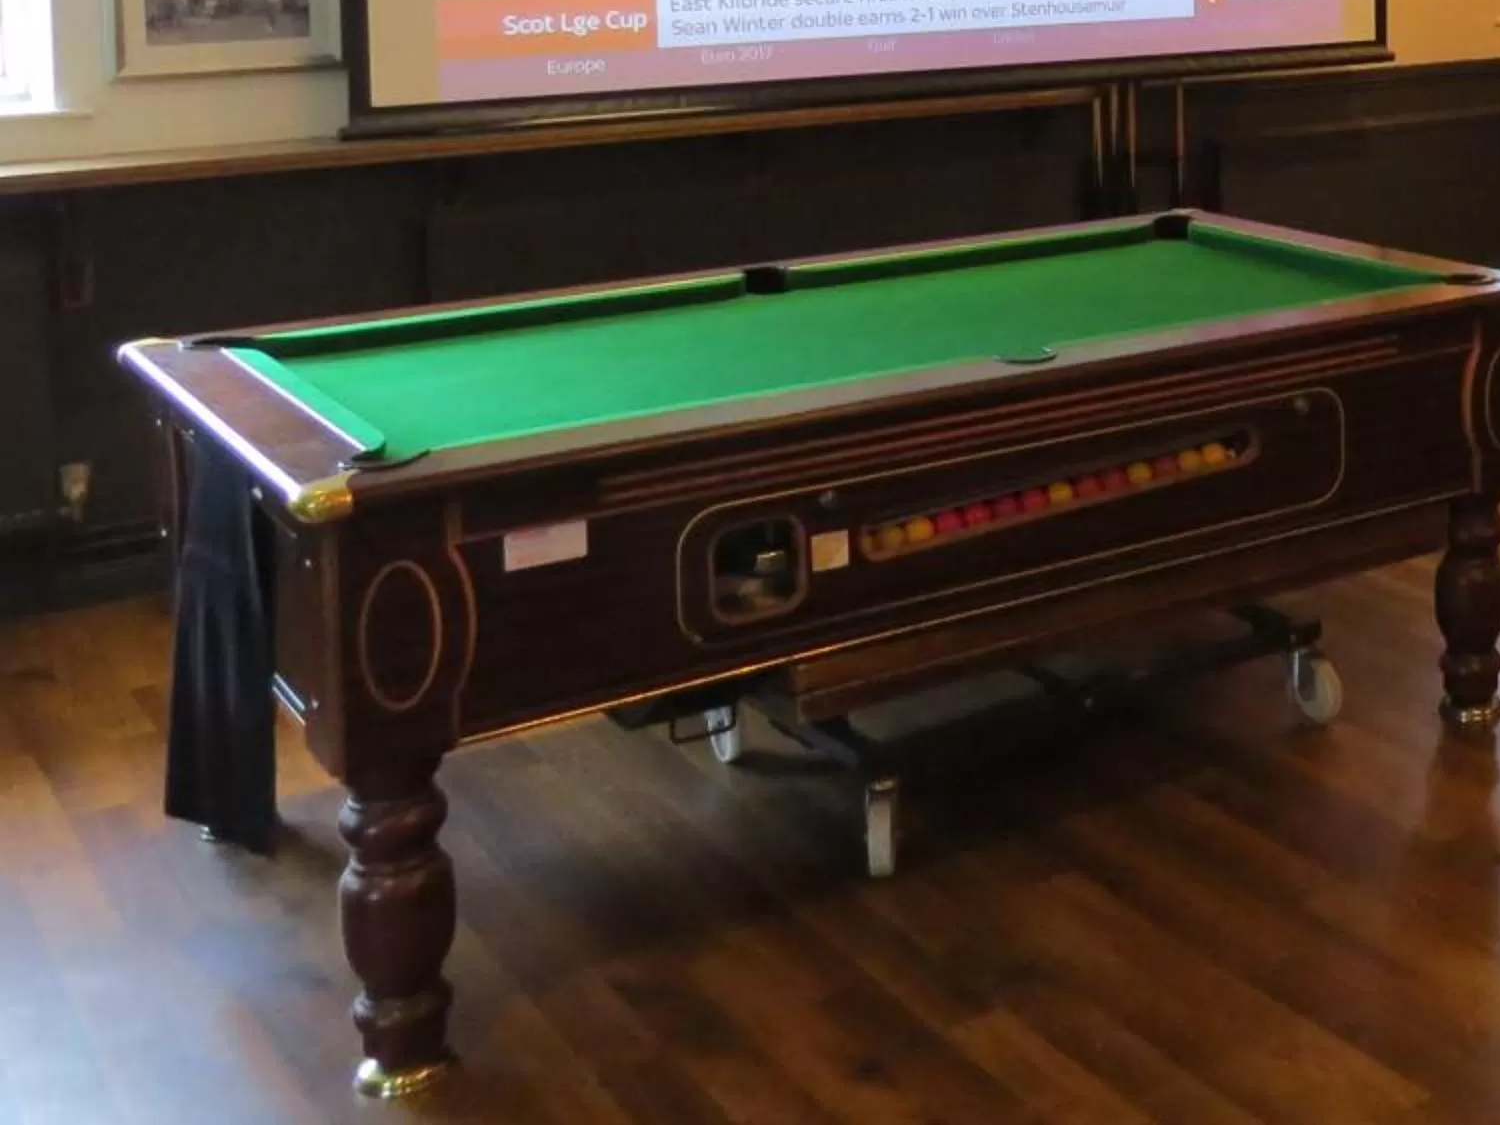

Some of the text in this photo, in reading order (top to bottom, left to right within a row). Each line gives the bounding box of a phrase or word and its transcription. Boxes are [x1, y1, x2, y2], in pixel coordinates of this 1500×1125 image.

[503, 10, 648, 36] Scot Lge Cup
[671, 0, 1127, 36] Sean Winter double earns 2-1 win over Stenhousemuir
[547, 59, 606, 78] Europe
